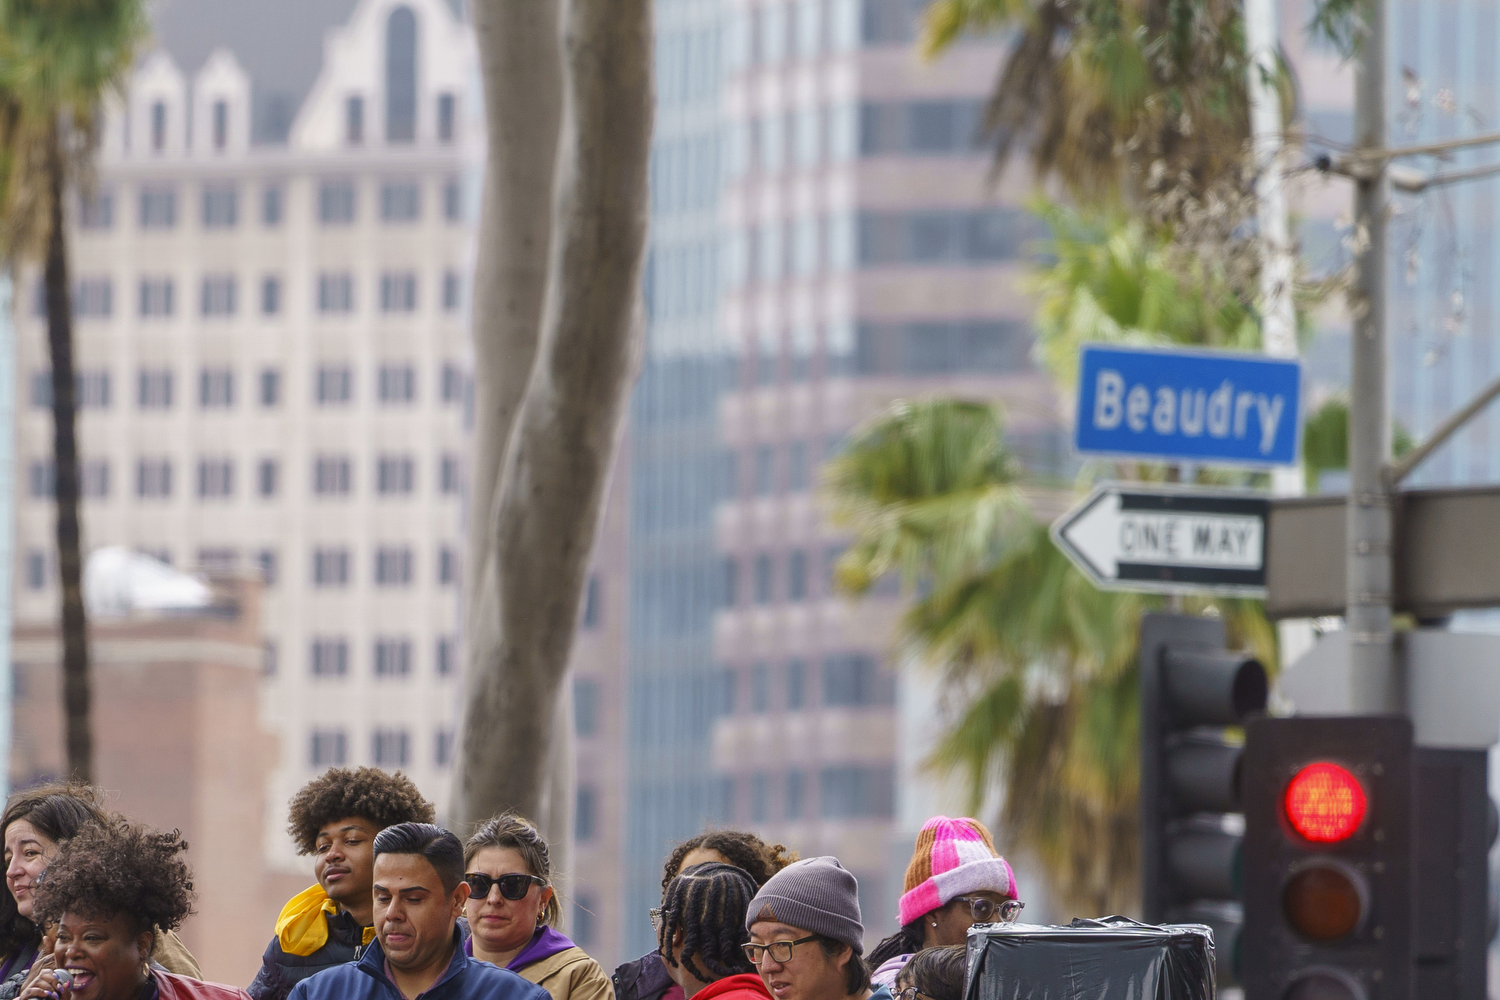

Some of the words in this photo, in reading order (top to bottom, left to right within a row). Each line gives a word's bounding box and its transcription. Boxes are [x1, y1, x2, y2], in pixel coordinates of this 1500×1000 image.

[1093, 369, 1284, 455] Beaudry
[1120, 520, 1181, 554] ONE
[1191, 523, 1254, 557] WAY
